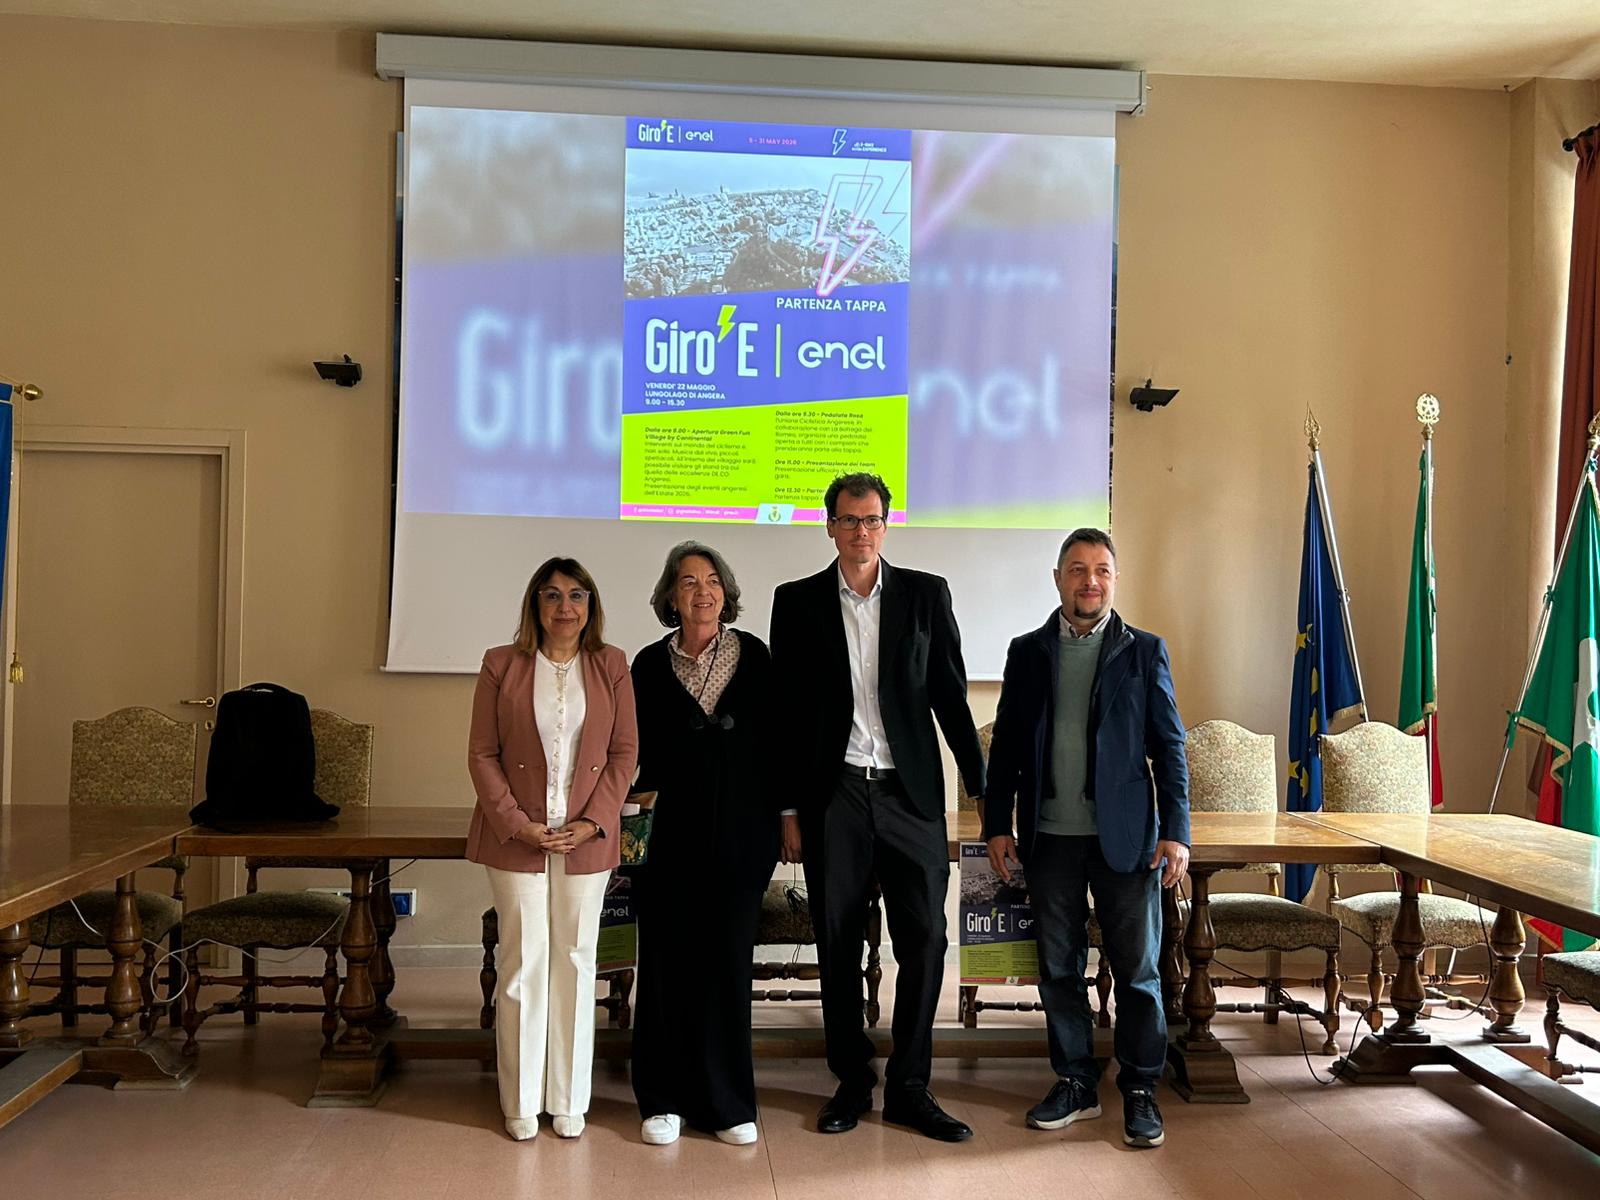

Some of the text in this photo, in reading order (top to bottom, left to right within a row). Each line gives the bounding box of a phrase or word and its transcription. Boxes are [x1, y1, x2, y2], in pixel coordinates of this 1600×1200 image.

[686, 130, 713, 142] enel
[776, 297, 886, 312] PARTENZA TAPPA
[798, 336, 885, 370] enel
[686, 383, 716, 391] MAGGIO
[600, 906, 628, 917] enel
